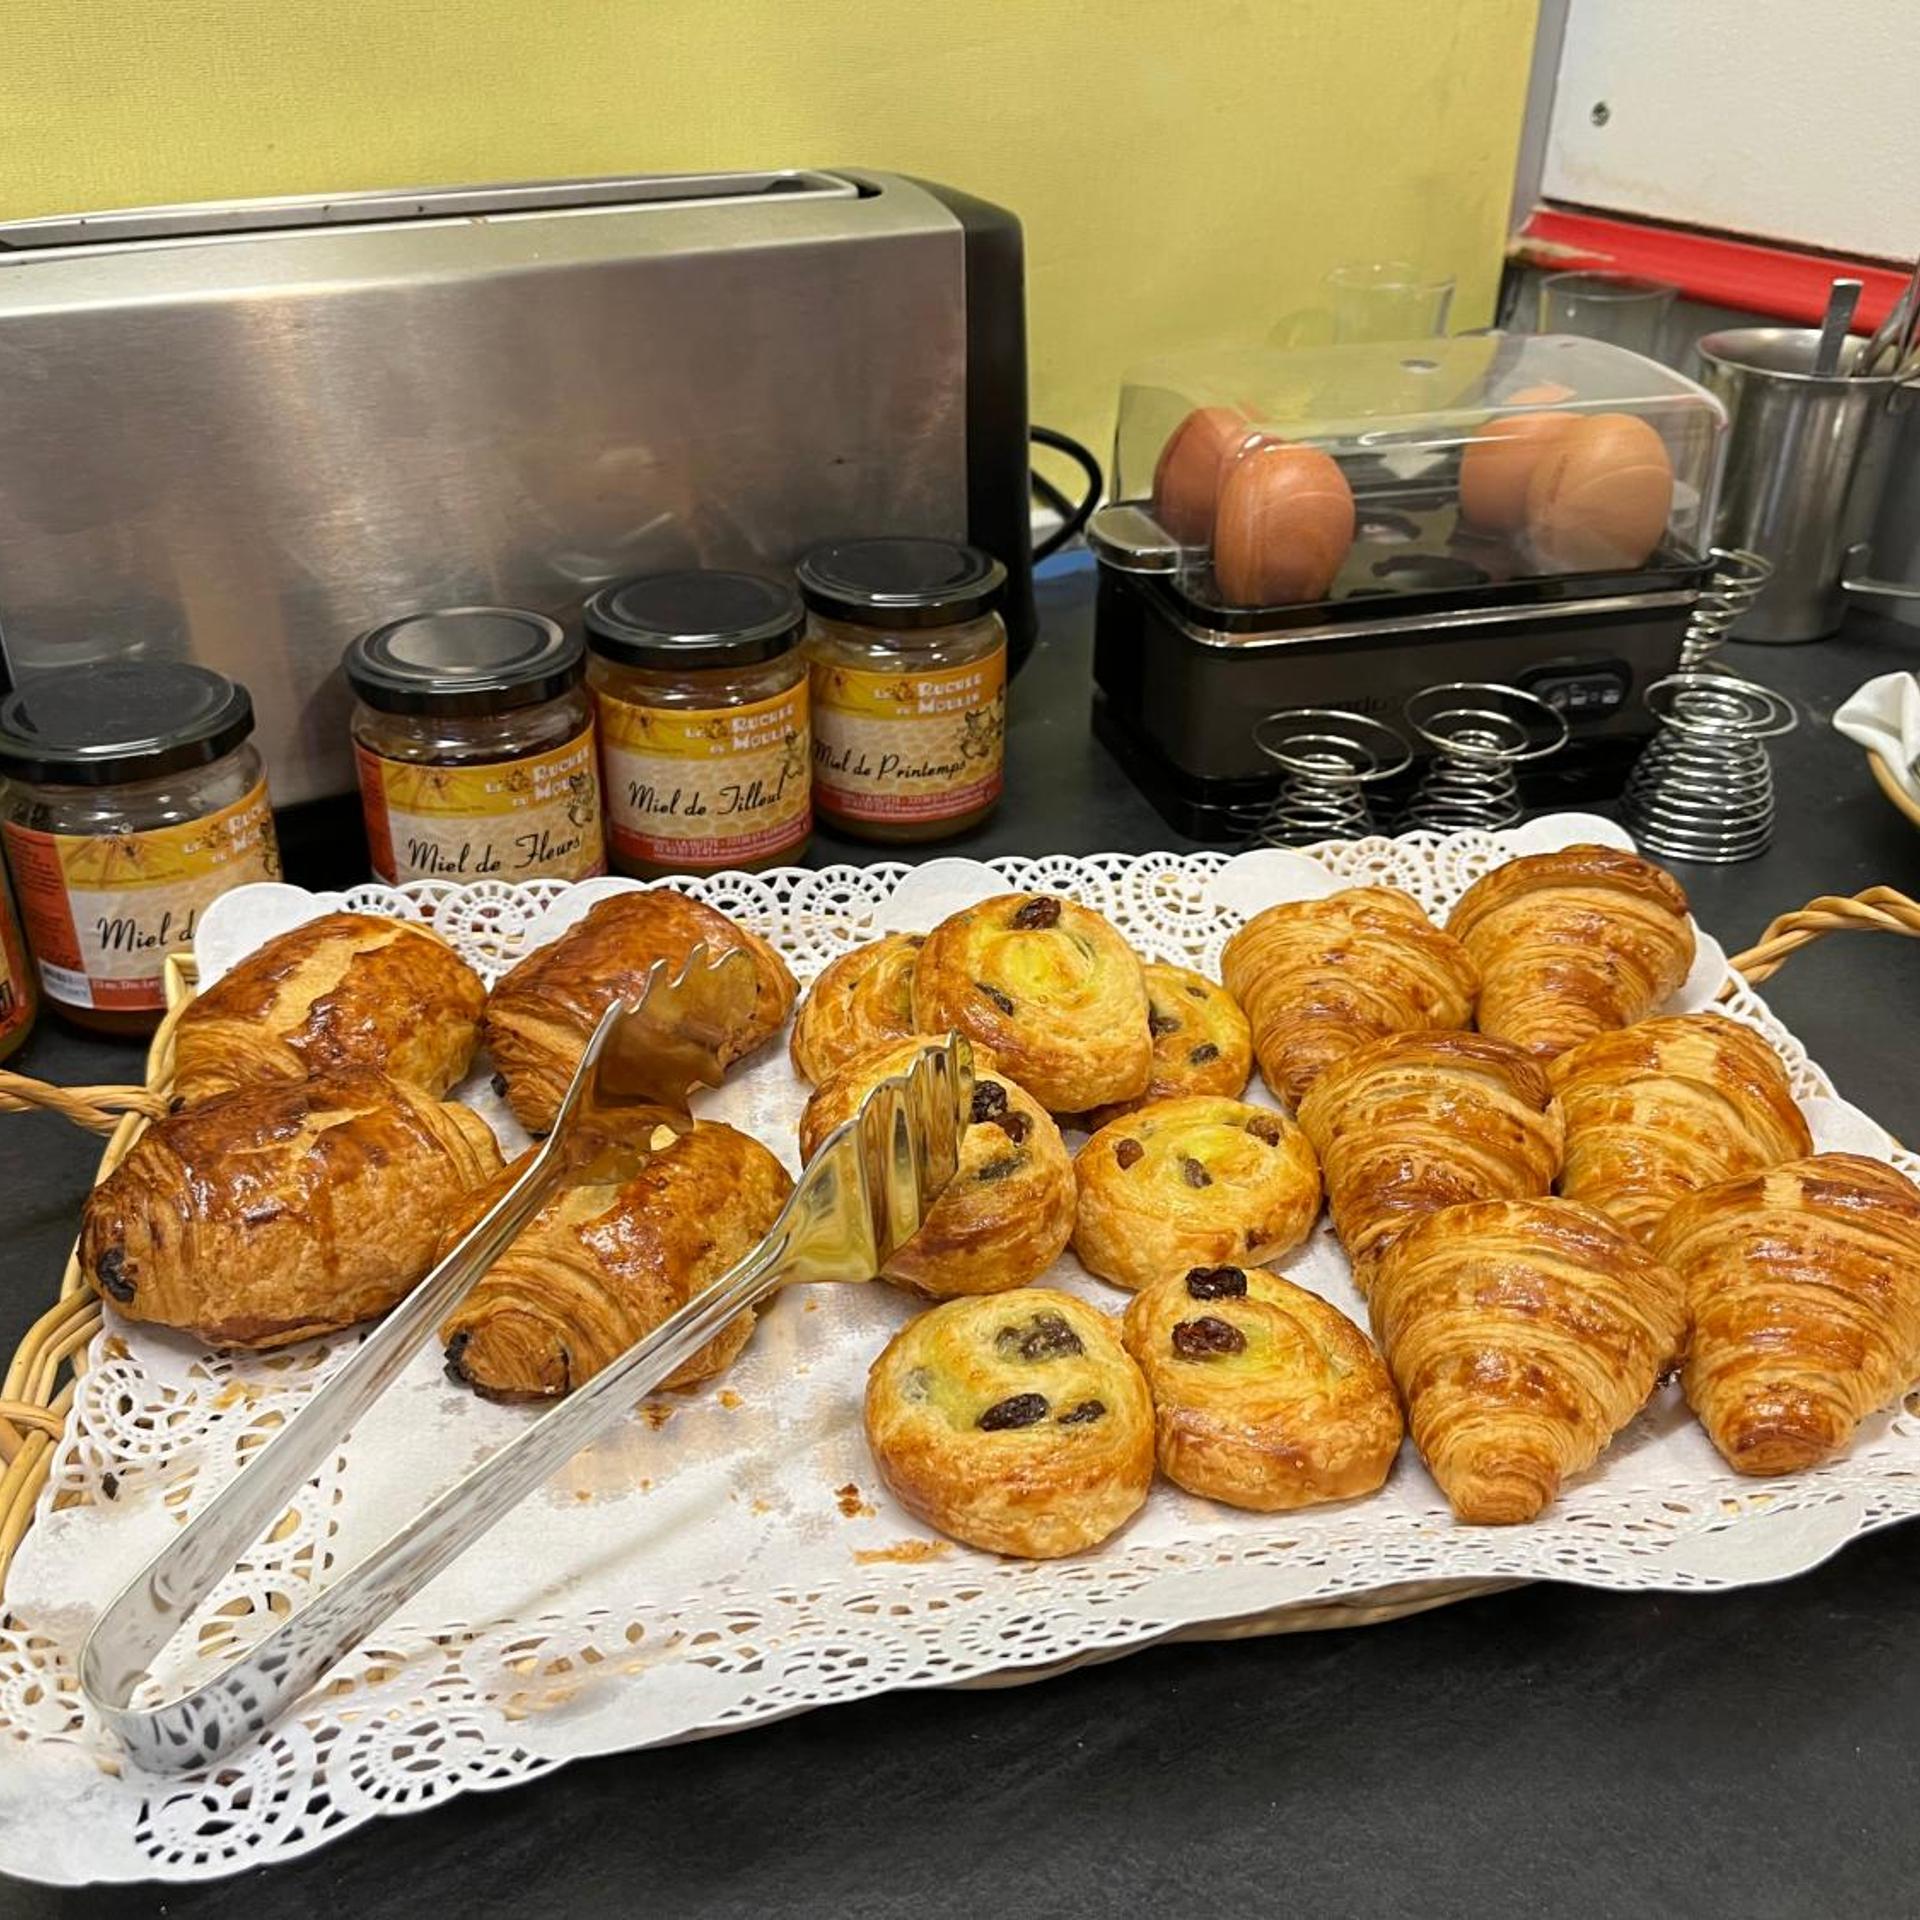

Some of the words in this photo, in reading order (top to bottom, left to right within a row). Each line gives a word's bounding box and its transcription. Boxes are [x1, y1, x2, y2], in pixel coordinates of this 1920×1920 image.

[814, 739, 851, 773] Miel
[853, 754, 872, 776] de
[877, 753, 966, 781] Printemps
[628, 780, 681, 815] Miel
[684, 792, 707, 816] de
[408, 838, 470, 873] Miel
[475, 845, 501, 873] de
[514, 831, 581, 868] Fleurs
[97, 912, 171, 952] Miel
